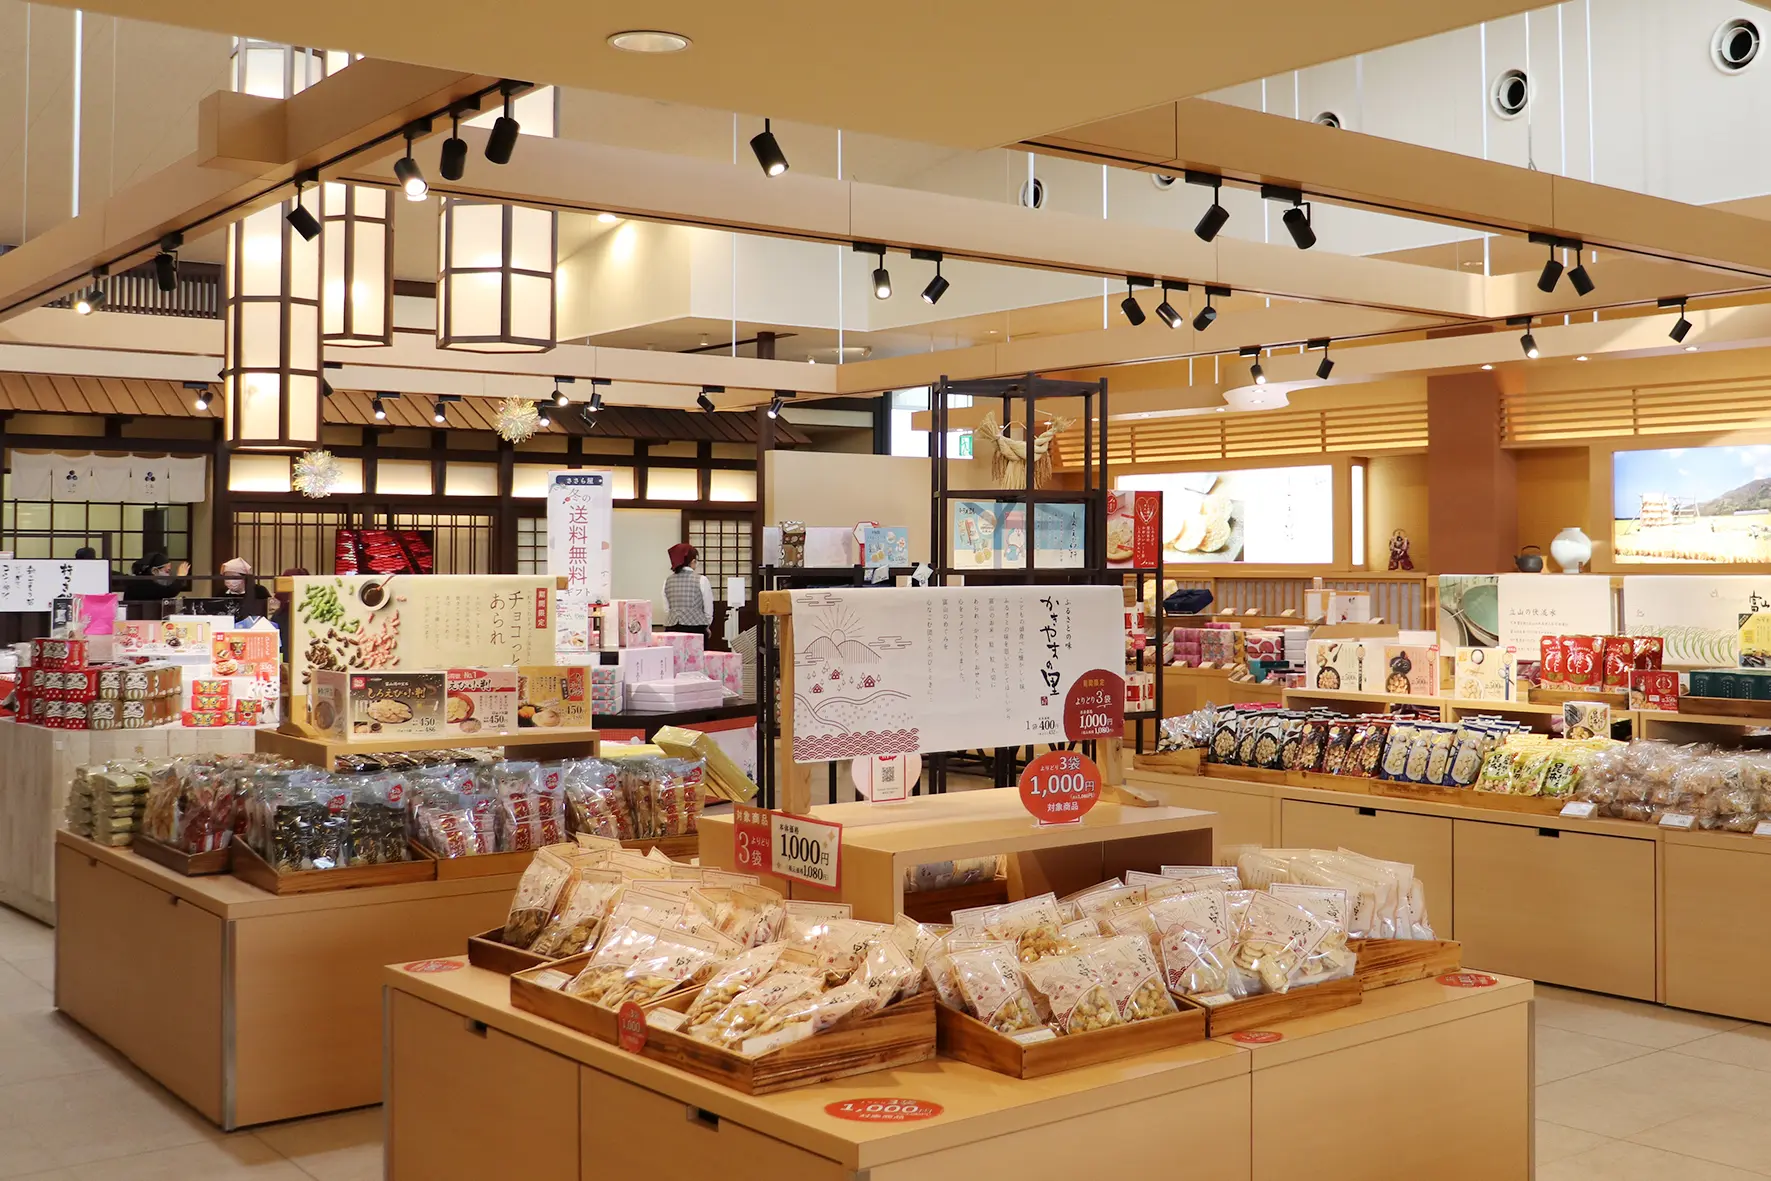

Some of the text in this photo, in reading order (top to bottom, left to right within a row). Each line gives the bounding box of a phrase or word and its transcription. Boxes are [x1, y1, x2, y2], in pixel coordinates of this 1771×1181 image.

[566, 477, 594, 485] ささら屋
[568, 487, 592, 503] 冬の
[568, 505, 588, 585] 送料無料
[564, 587, 591, 597] ギフト
[537, 590, 547, 627] 期間限定
[489, 593, 506, 645] あられ
[1064, 597, 1073, 650] ふるさとの味
[508, 591, 524, 665] チョコっと
[1040, 596, 1060, 696] かきやまの里
[367, 687, 427, 699] しろえび小判
[1075, 690, 1112, 705] よりどり3袋
[1079, 713, 1112, 729] 1,000円
[1040, 756, 1080, 771] よりどり3袋
[1030, 773, 1094, 797] 1,000円
[1047, 801, 1079, 812] 対象商品
[736, 809, 768, 826] 対象商品
[779, 823, 799, 835] 本体価格
[751, 836, 770, 848] よりどり
[781, 833, 830, 866] 1,000円
[840, 1103, 933, 1114] 1,000円
